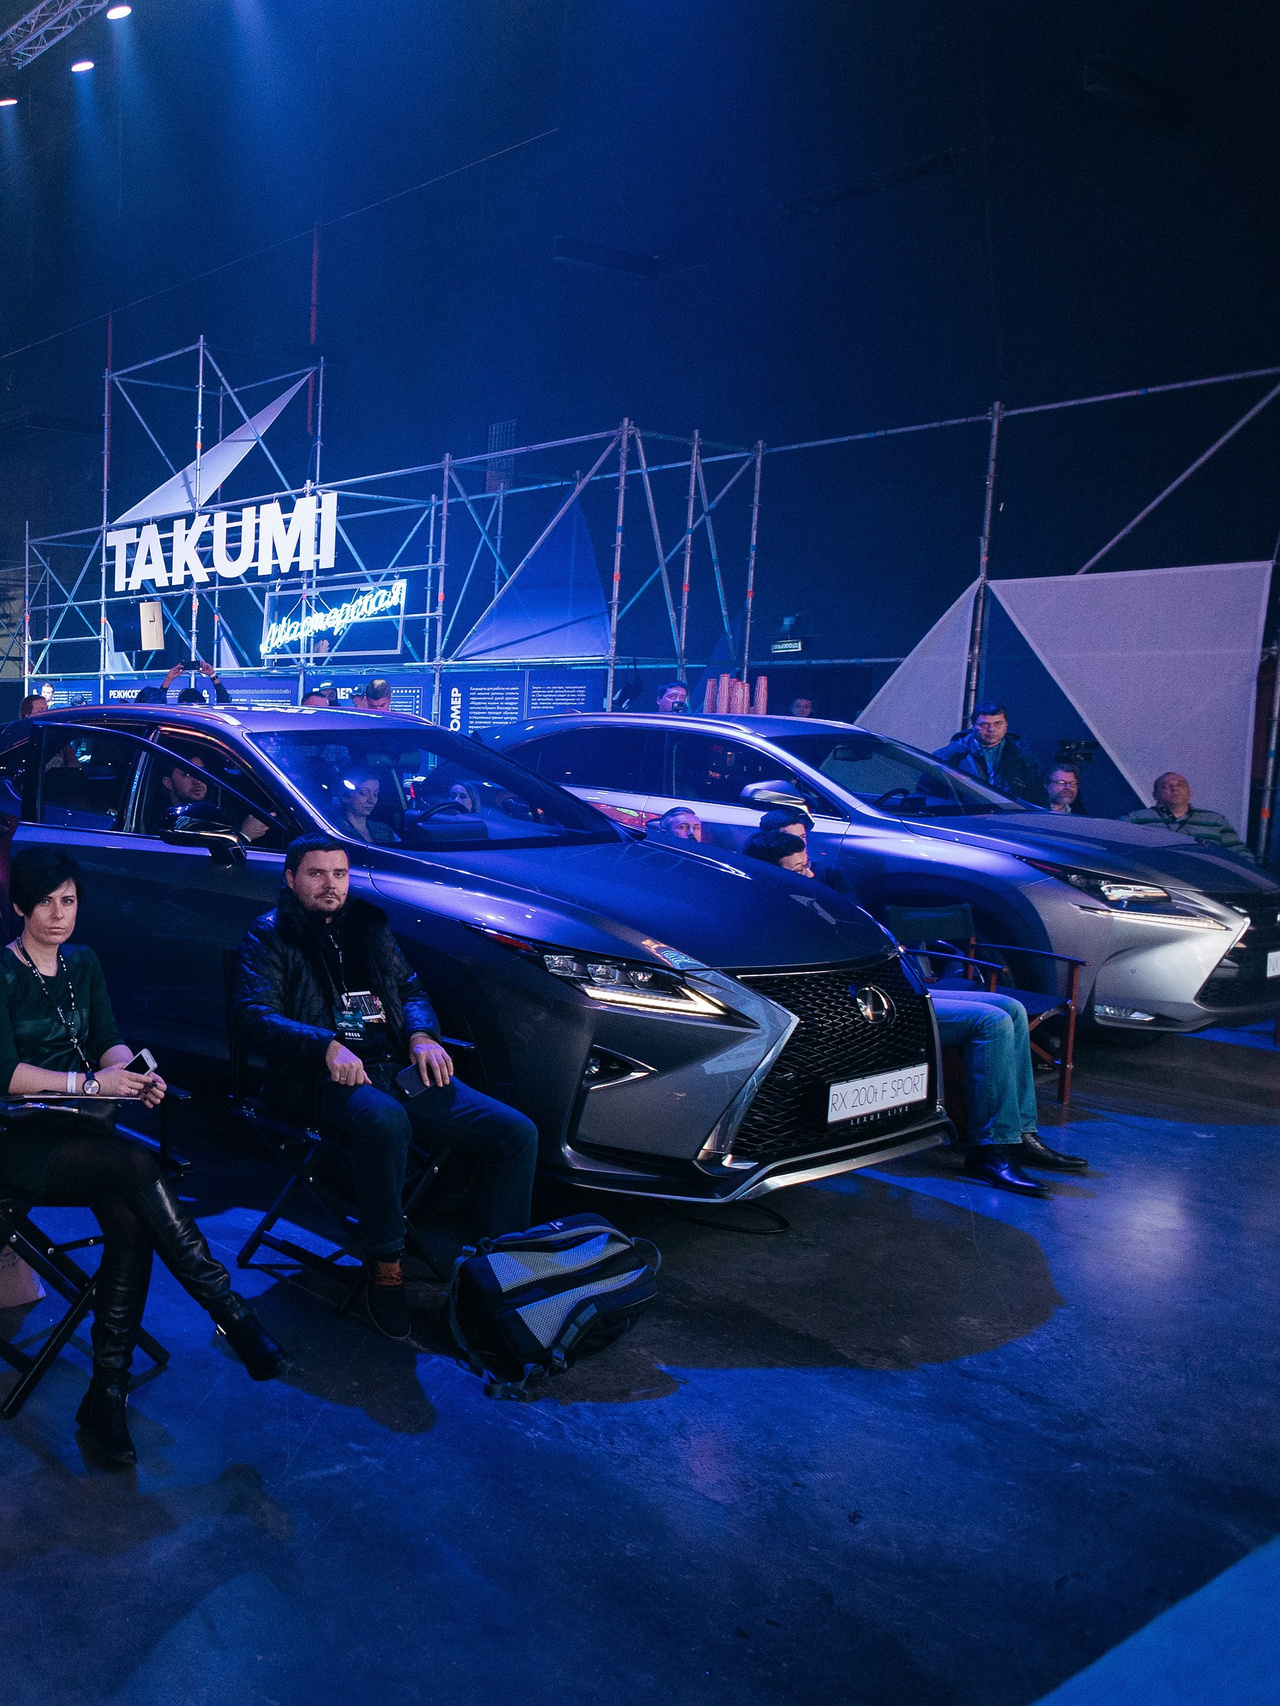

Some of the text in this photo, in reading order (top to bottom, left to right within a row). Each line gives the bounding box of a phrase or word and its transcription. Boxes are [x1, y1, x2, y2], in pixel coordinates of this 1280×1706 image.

[107, 492, 338, 592] TAKUMI
[108, 690, 142, 699] РЕЖИССЕ
[830, 1092, 848, 1112] RX
[881, 1082, 888, 1101] F
[890, 1073, 926, 1099] SPORT
[850, 1105, 909, 1125] LEXUS LIVE
